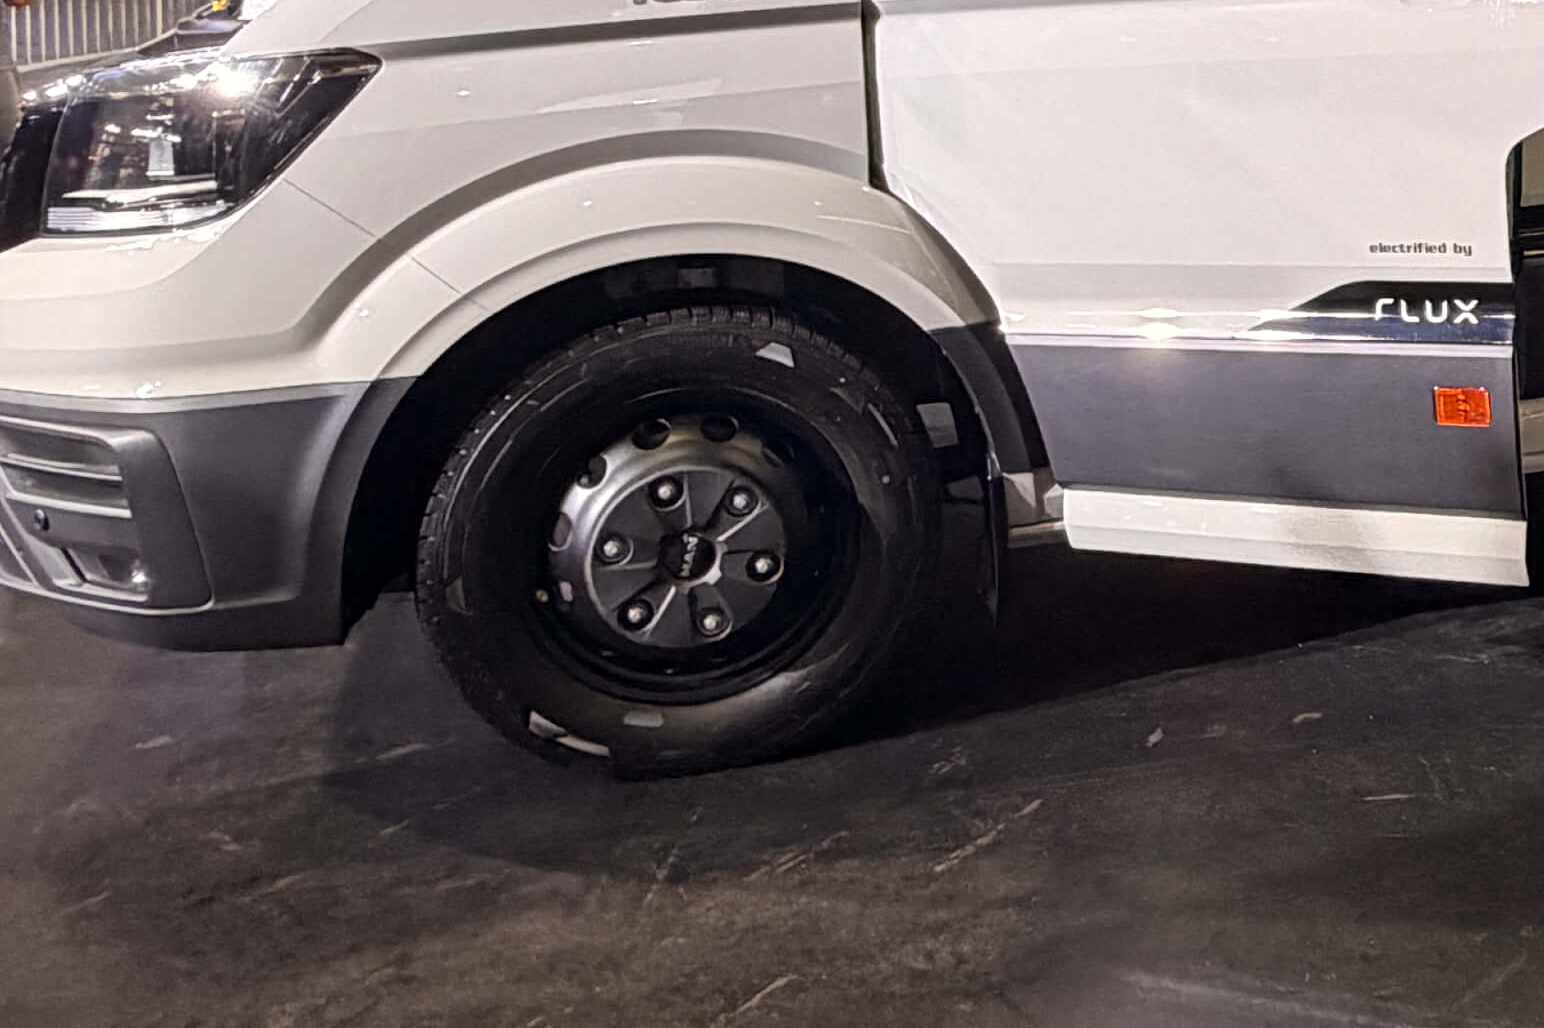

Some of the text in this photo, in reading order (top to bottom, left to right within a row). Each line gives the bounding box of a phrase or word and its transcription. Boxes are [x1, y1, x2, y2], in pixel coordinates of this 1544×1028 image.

[1369, 241, 1473, 257] electrified by
[1373, 297, 1480, 325] FLUX
